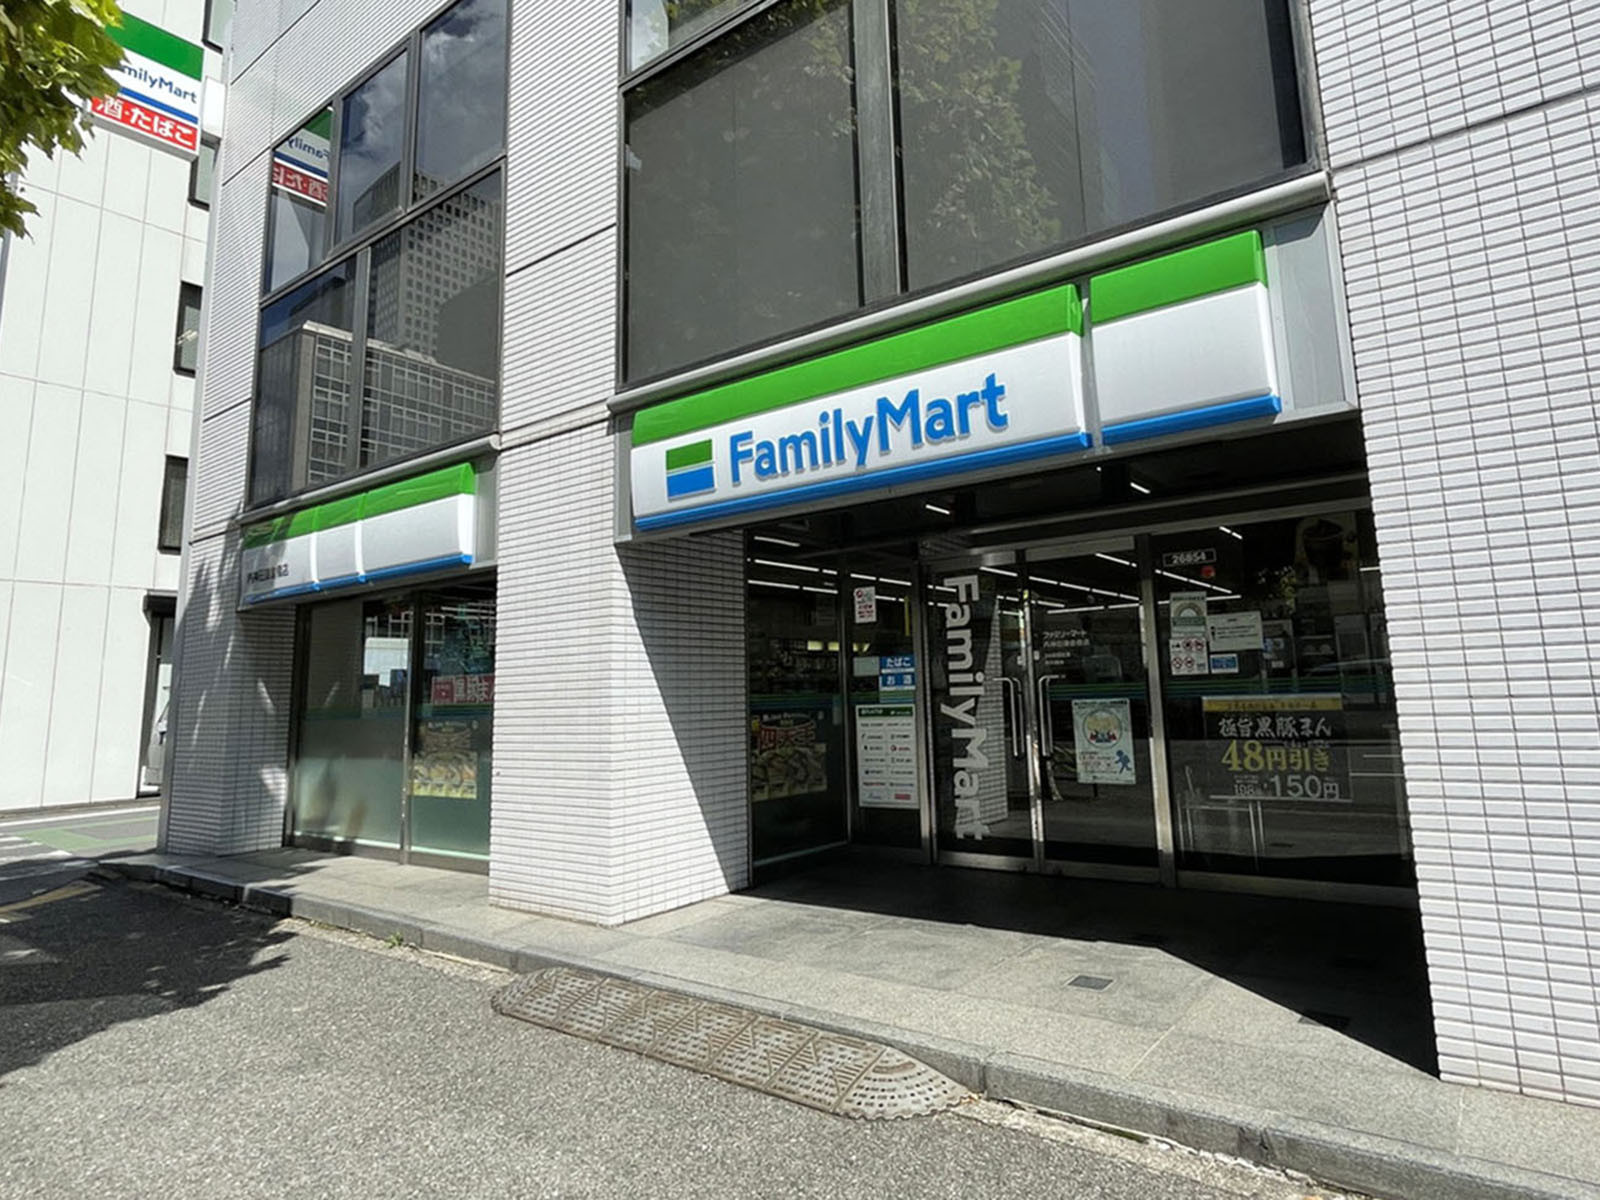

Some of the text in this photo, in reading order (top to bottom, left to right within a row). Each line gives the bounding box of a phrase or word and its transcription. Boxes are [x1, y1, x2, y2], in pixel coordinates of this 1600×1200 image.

[121, 65, 198, 105] milyMart
[728, 372, 1009, 487] FamilyMart
[940, 574, 991, 841] FamilyMart
[1220, 739, 1330, 772] 48円引き
[1269, 774, 1341, 801] 150円
